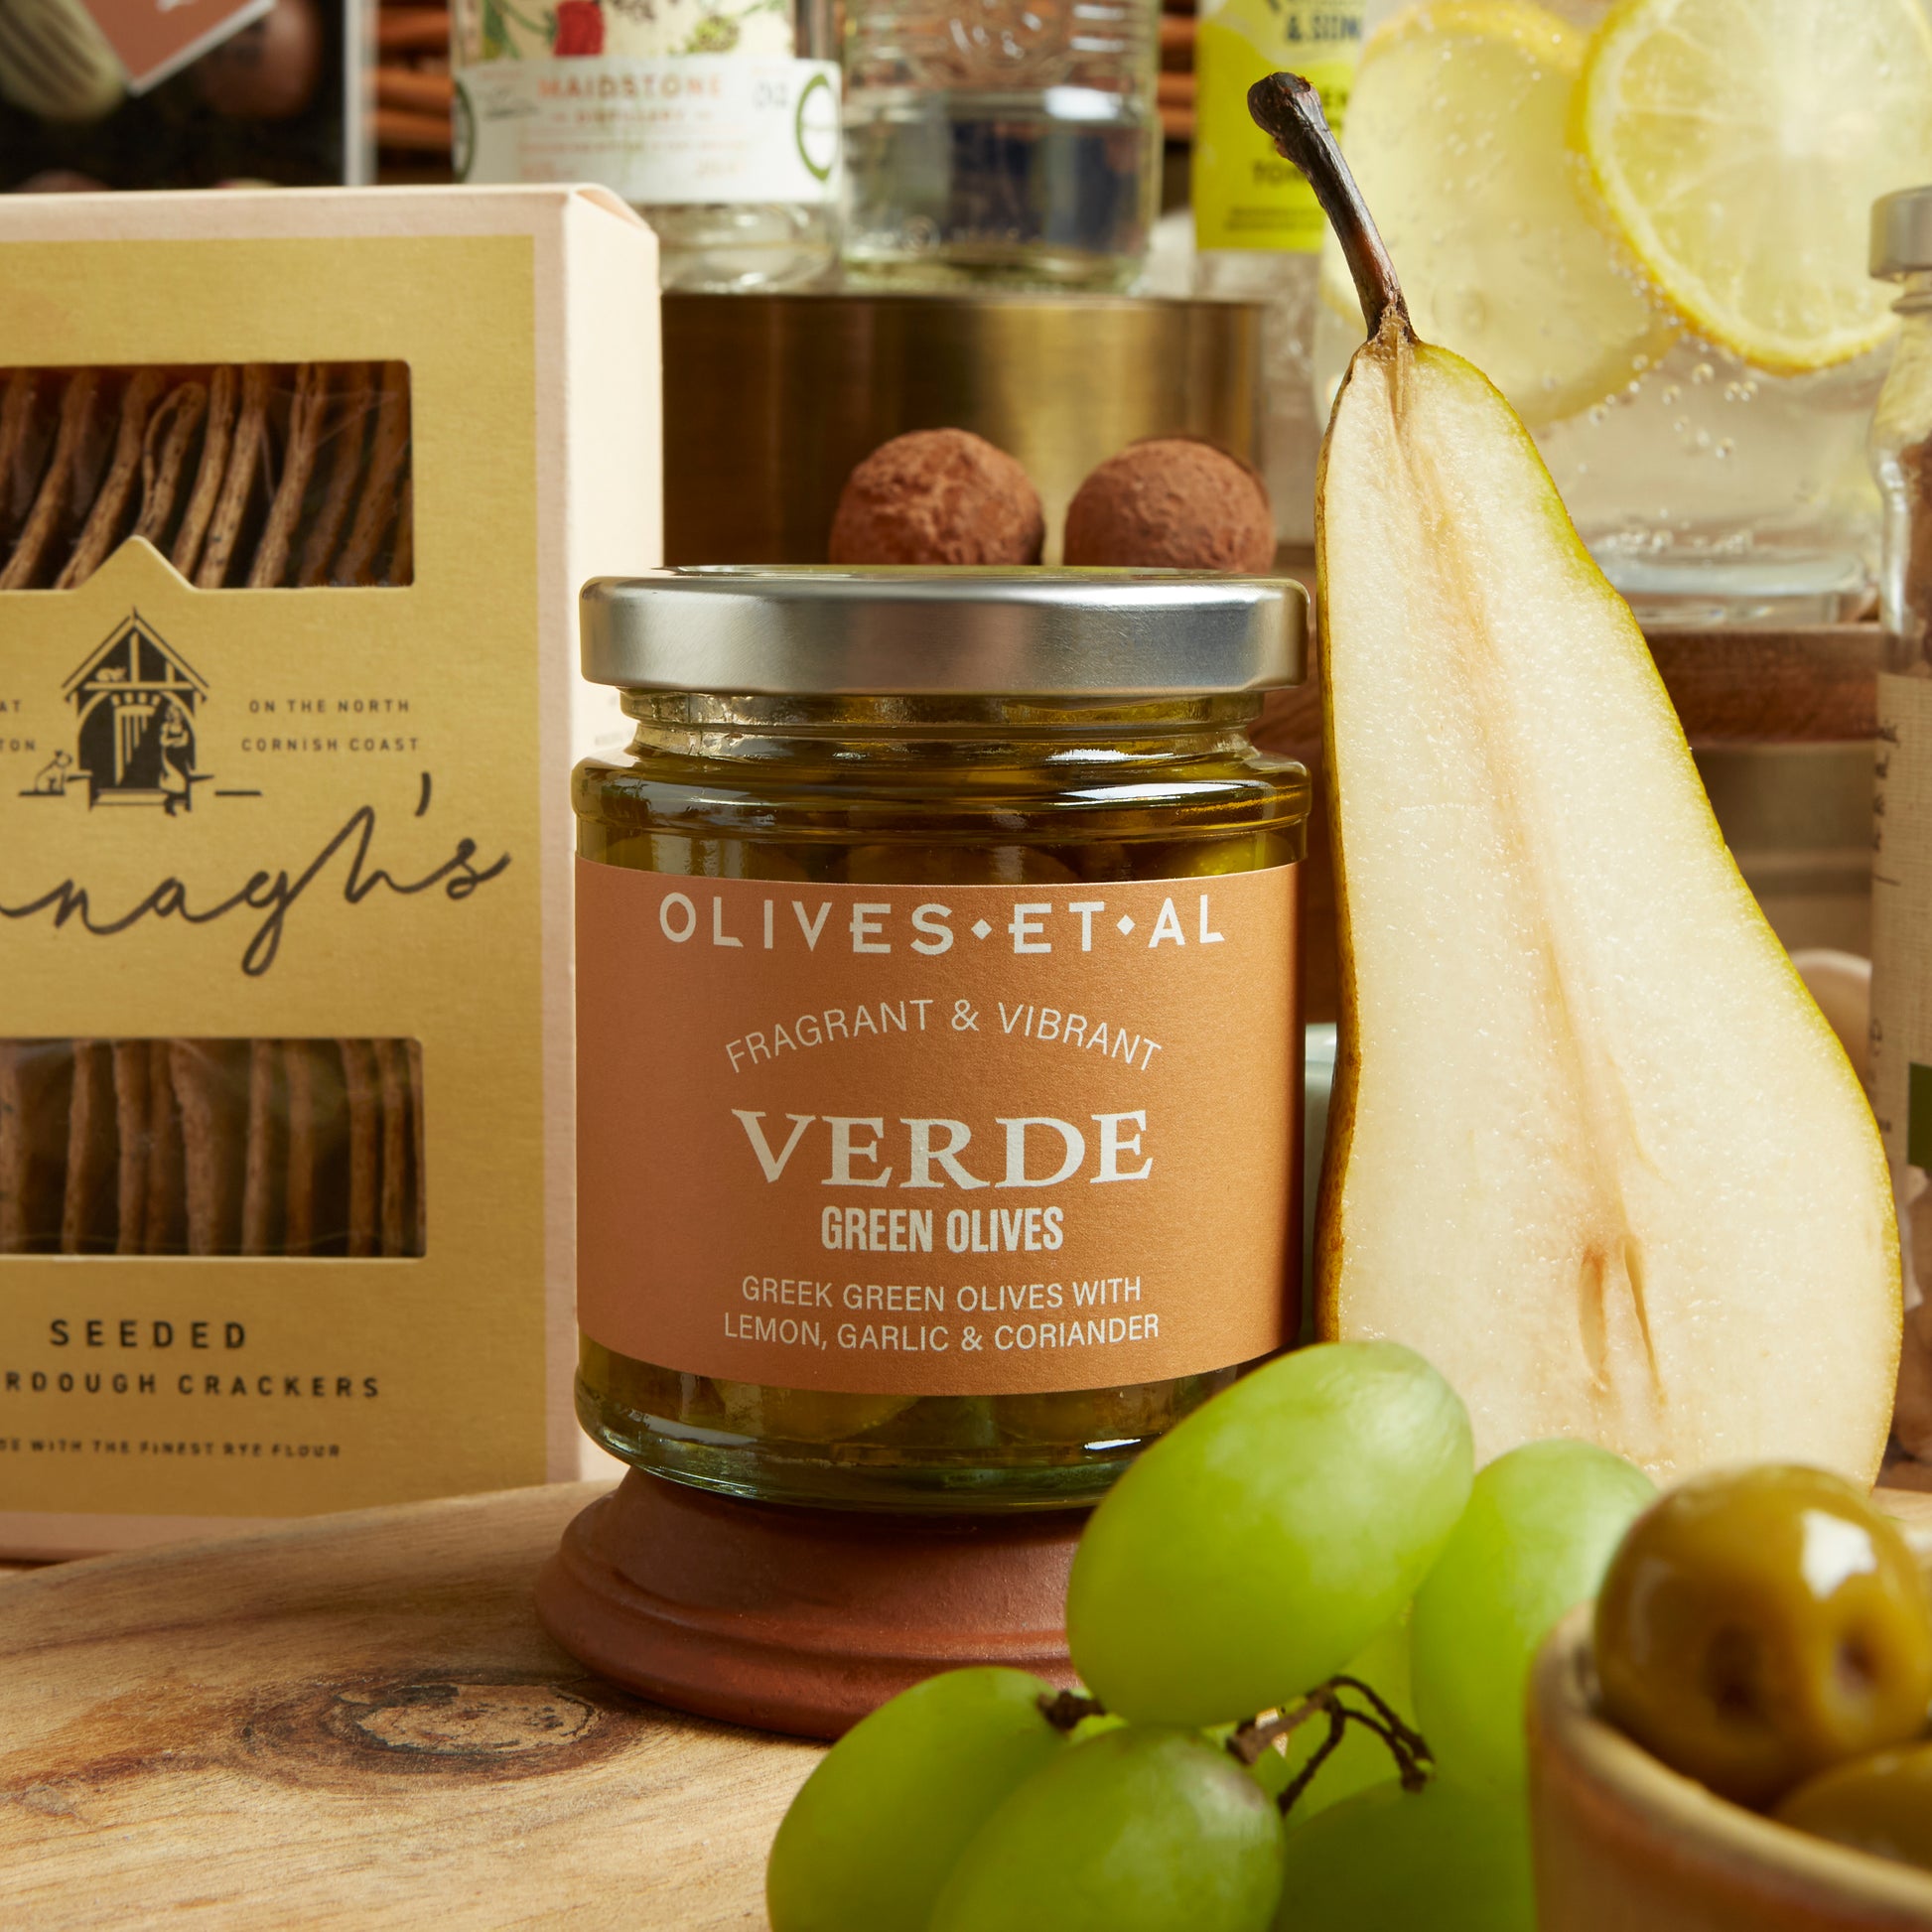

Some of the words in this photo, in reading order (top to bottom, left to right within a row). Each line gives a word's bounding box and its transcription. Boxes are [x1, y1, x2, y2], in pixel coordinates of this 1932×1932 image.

[249, 700, 276, 713] ON
[287, 700, 327, 713] THE
[338, 700, 410, 713] NORTH
[241, 738, 338, 752] CORNISH
[349, 738, 418, 752] COAST
[659, 892, 955, 955] OLIVES
[1007, 897, 1108, 954] ET
[1148, 894, 1227, 950] AL
[725, 999, 935, 1074] FRAGRANT
[951, 999, 980, 1032] &
[998, 1002, 1164, 1071] VIBRANT
[731, 1108, 1154, 1190] VERDE
[821, 1206, 933, 1253] GREEN
[945, 1206, 1065, 1253] OLIVES
[742, 1276, 834, 1309] GREEK
[843, 1284, 945, 1311] GREEN
[956, 1283, 1063, 1312] OLIVES
[1071, 1276, 1143, 1308] WITH
[50, 1319, 246, 1349] SEEDED
[724, 1312, 828, 1350] LEMON,
[837, 1323, 949, 1351] GARLIC
[960, 1325, 983, 1351] &
[994, 1313, 1160, 1351] CORIANDER
[6, 1371, 156, 1393] RDOUGH
[178, 1375, 379, 1397] CRACKERS
[31, 1440, 82, 1452] WITH
[93, 1440, 130, 1454] THE
[141, 1442, 214, 1455] FINEST
[224, 1443, 263, 1456] RYE
[272, 1445, 341, 1458] FLOUR
